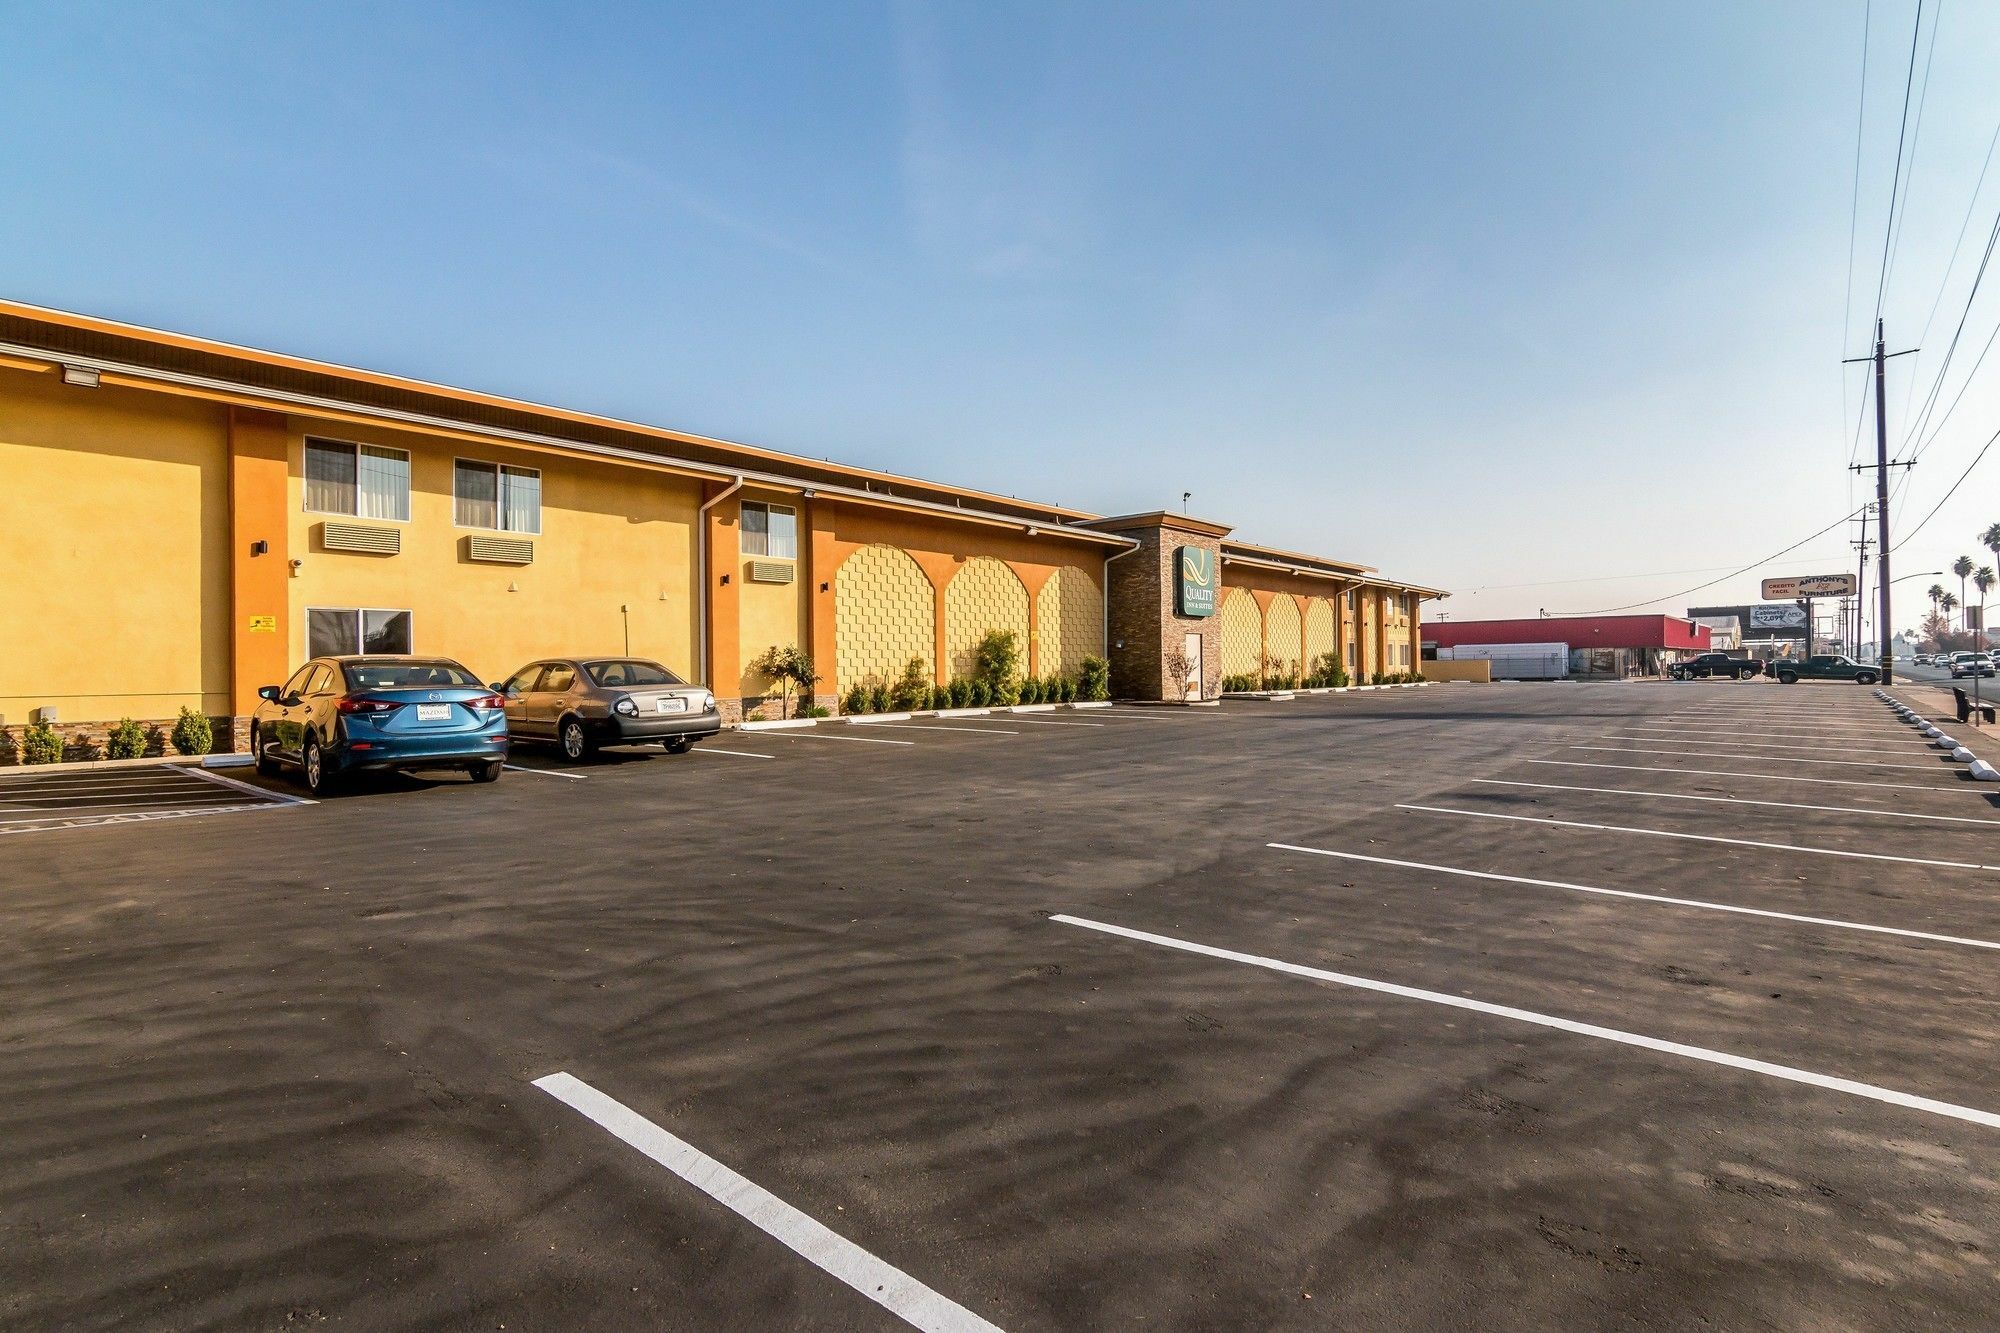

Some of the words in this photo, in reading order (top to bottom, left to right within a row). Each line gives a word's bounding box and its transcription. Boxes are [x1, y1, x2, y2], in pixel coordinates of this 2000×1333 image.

[1799, 576, 1848, 586] ANTHONY'S
[1186, 585, 1213, 601] QUALITY
[1799, 588, 1848, 596] FURNITURE
